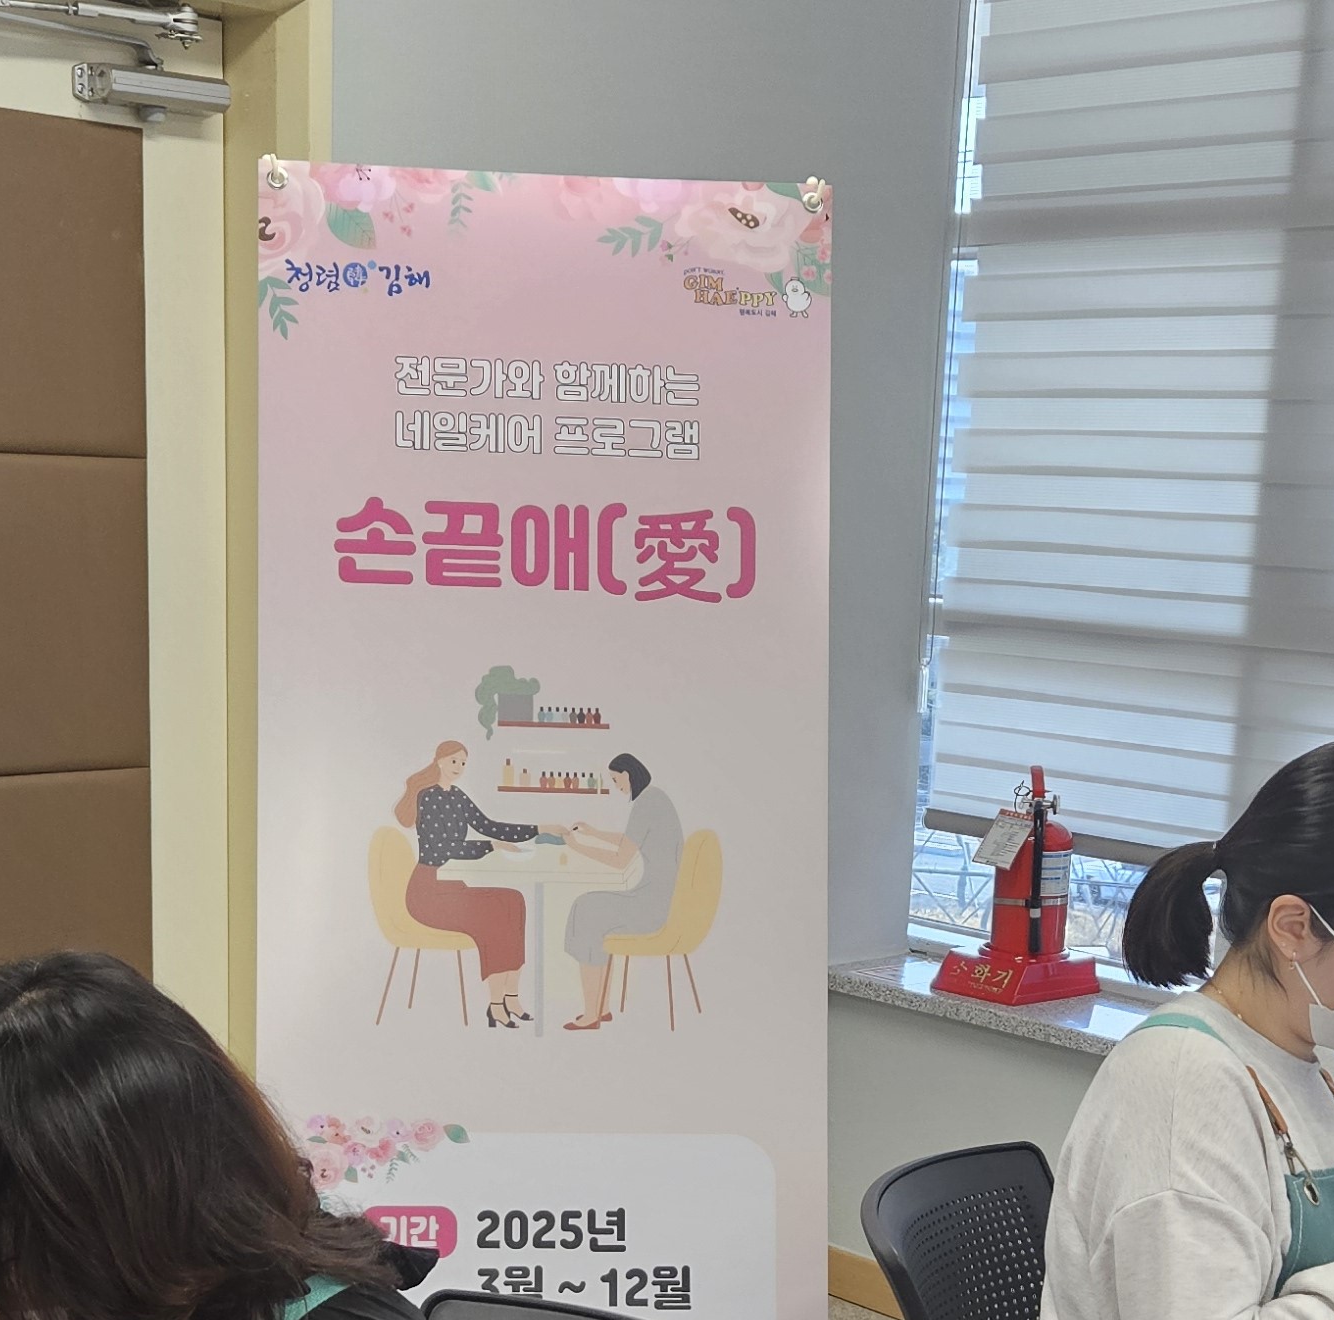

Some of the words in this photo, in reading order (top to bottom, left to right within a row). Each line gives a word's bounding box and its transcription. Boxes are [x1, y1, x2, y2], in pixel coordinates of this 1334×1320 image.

[378, 263, 431, 297] 김해
[683, 273, 724, 292] GIM
[394, 355, 544, 400] 전문가와
[553, 361, 701, 405] 함께하는
[394, 410, 544, 455] 네일케어
[553, 416, 701, 460] 프로그램
[333, 496, 757, 604] 손끝애(愛)
[380, 1215, 440, 1247] 기간
[476, 1207, 628, 1253] 2025년
[477, 1265, 543, 1299] 3월
[600, 1265, 692, 1310] 12월
